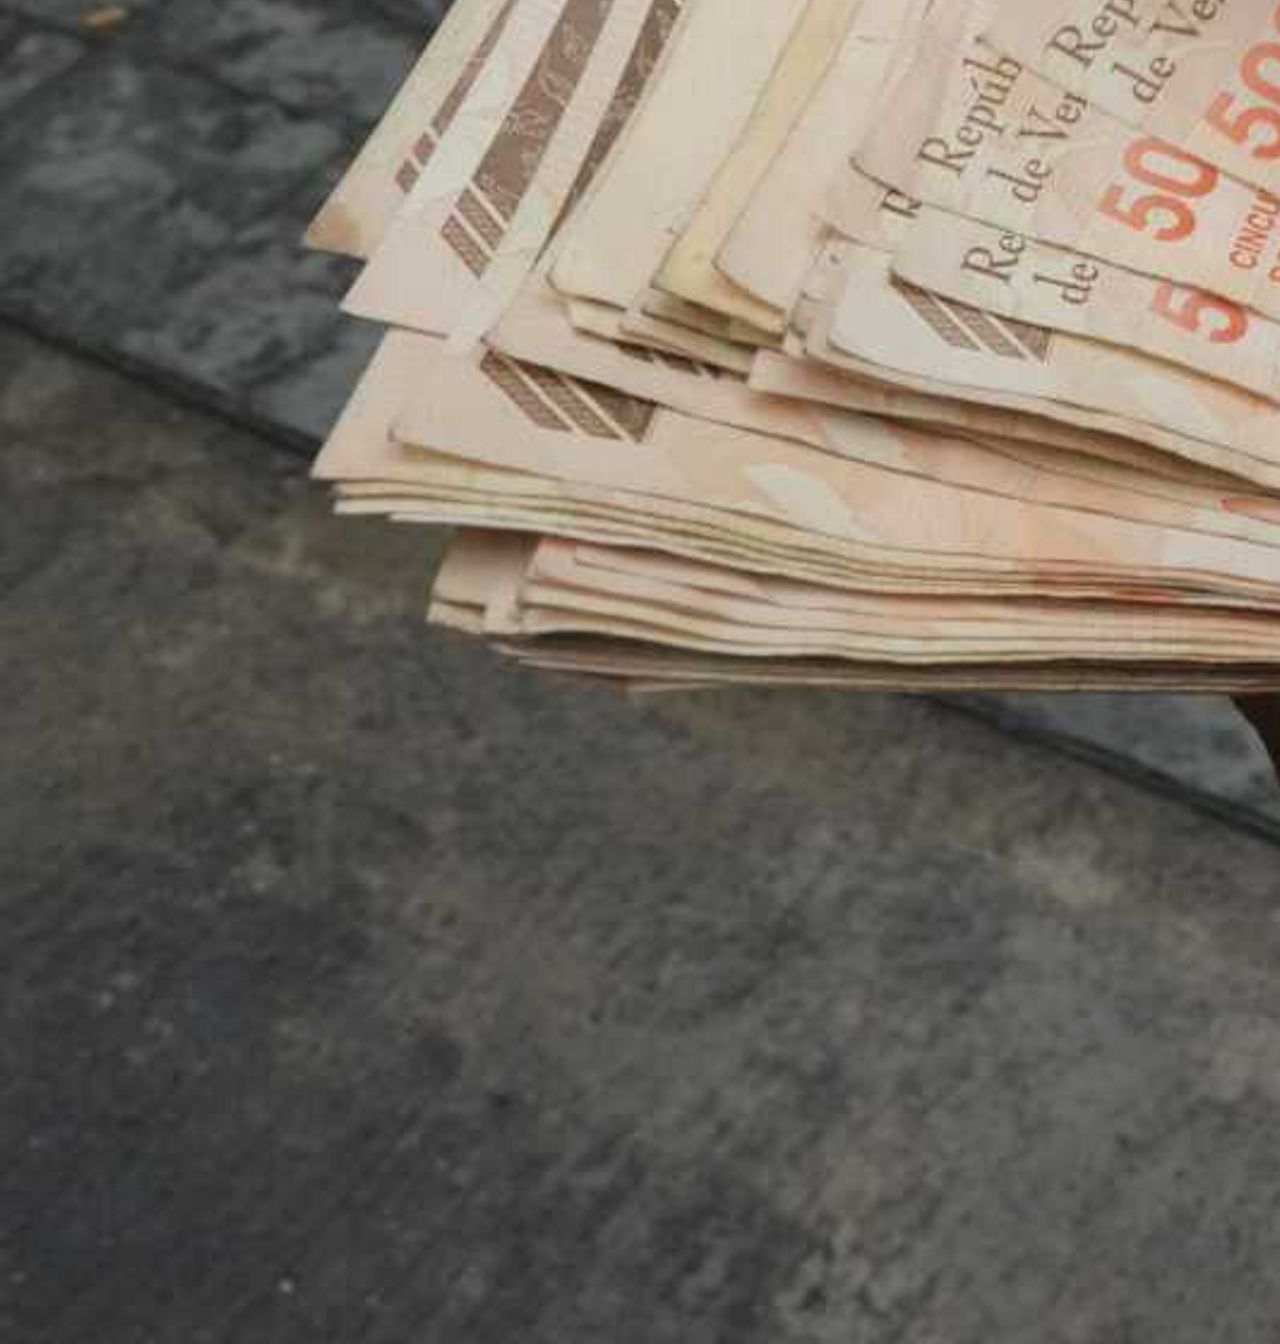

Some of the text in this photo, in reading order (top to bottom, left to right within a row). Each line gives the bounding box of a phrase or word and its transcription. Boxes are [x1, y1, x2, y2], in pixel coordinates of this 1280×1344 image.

[1112, 56, 1176, 105] de
[988, 158, 1052, 204] de
[1098, 136, 1219, 242] 50
[1033, 263, 1100, 306] de
